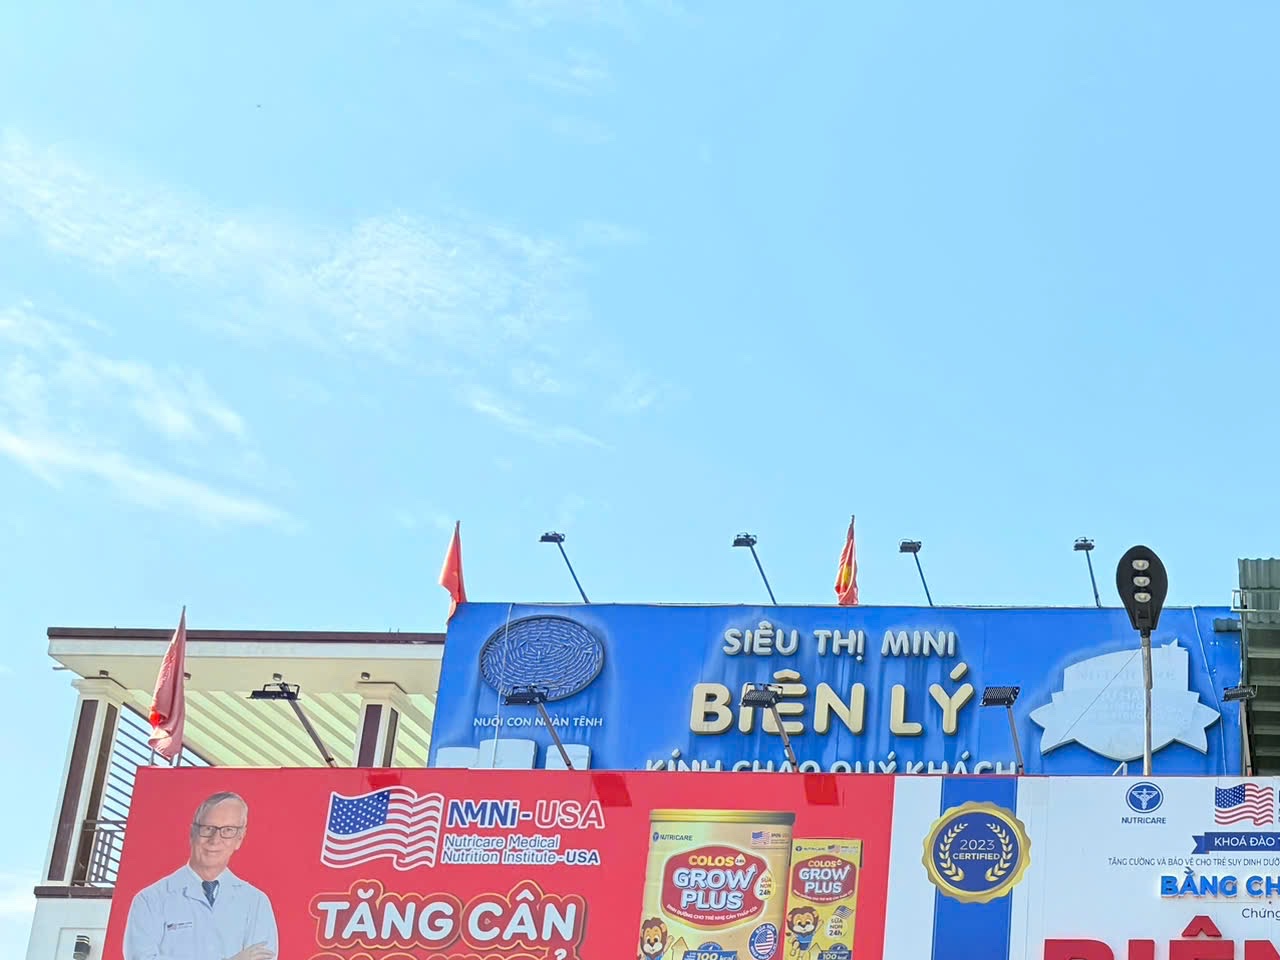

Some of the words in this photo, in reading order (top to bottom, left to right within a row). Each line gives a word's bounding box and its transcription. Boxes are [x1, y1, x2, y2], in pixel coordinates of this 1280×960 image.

[723, 620, 799, 656] SIÊU
[813, 629, 865, 664] THỊ
[881, 629, 956, 657] MINI
[690, 668, 865, 735] BIÊN
[889, 662, 975, 735] LÝ
[507, 717, 532, 727] CON
[444, 834, 504, 849] Nutricare
[508, 834, 560, 849] Medical
[660, 834, 693, 842] NUTRICARE
[960, 839, 995, 850] 2023
[1214, 836, 1247, 848] KHOÁ
[1249, 836, 1274, 848] ĐÀO
[442, 850, 498, 864] Nutrition
[688, 854, 734, 867] COLOS
[673, 866, 750, 890] GROW
[1160, 867, 1238, 898] BẰNG
[681, 889, 743, 910] PLUS
[316, 890, 459, 941] TĂNG
[468, 891, 576, 941] CÂN
